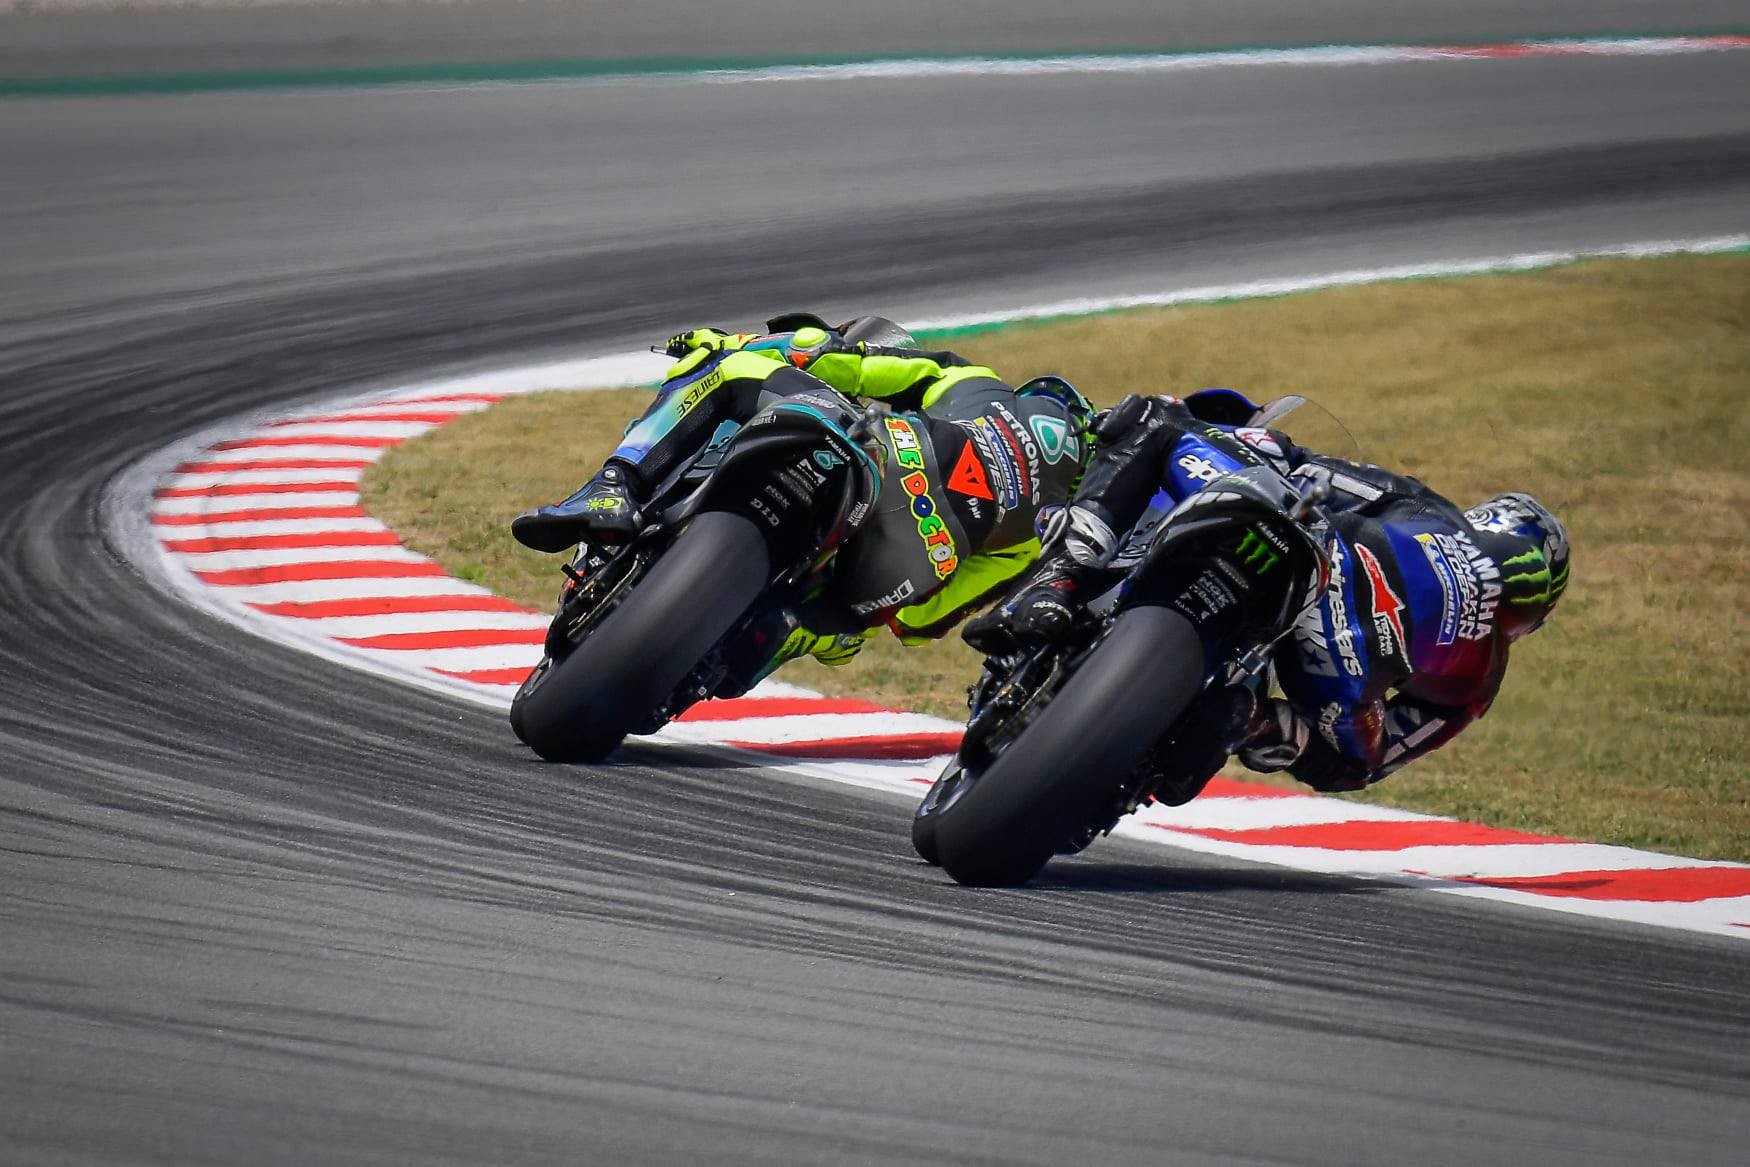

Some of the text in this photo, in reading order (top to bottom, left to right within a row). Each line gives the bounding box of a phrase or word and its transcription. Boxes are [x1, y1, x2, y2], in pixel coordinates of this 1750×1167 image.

[824, 434, 851, 461] YAMAHA
[986, 415, 1014, 456] RACING
[1012, 461, 1024, 495] TEAM
[991, 401, 1040, 506] PETRONAS
[992, 441, 1014, 500] MICHELIN
[885, 418, 958, 580] THE DOCTOR
[1256, 521, 1290, 554] YAMAHA
[1436, 562, 1455, 634] MICHELIN
[1453, 530, 1502, 640] YAMAHA
